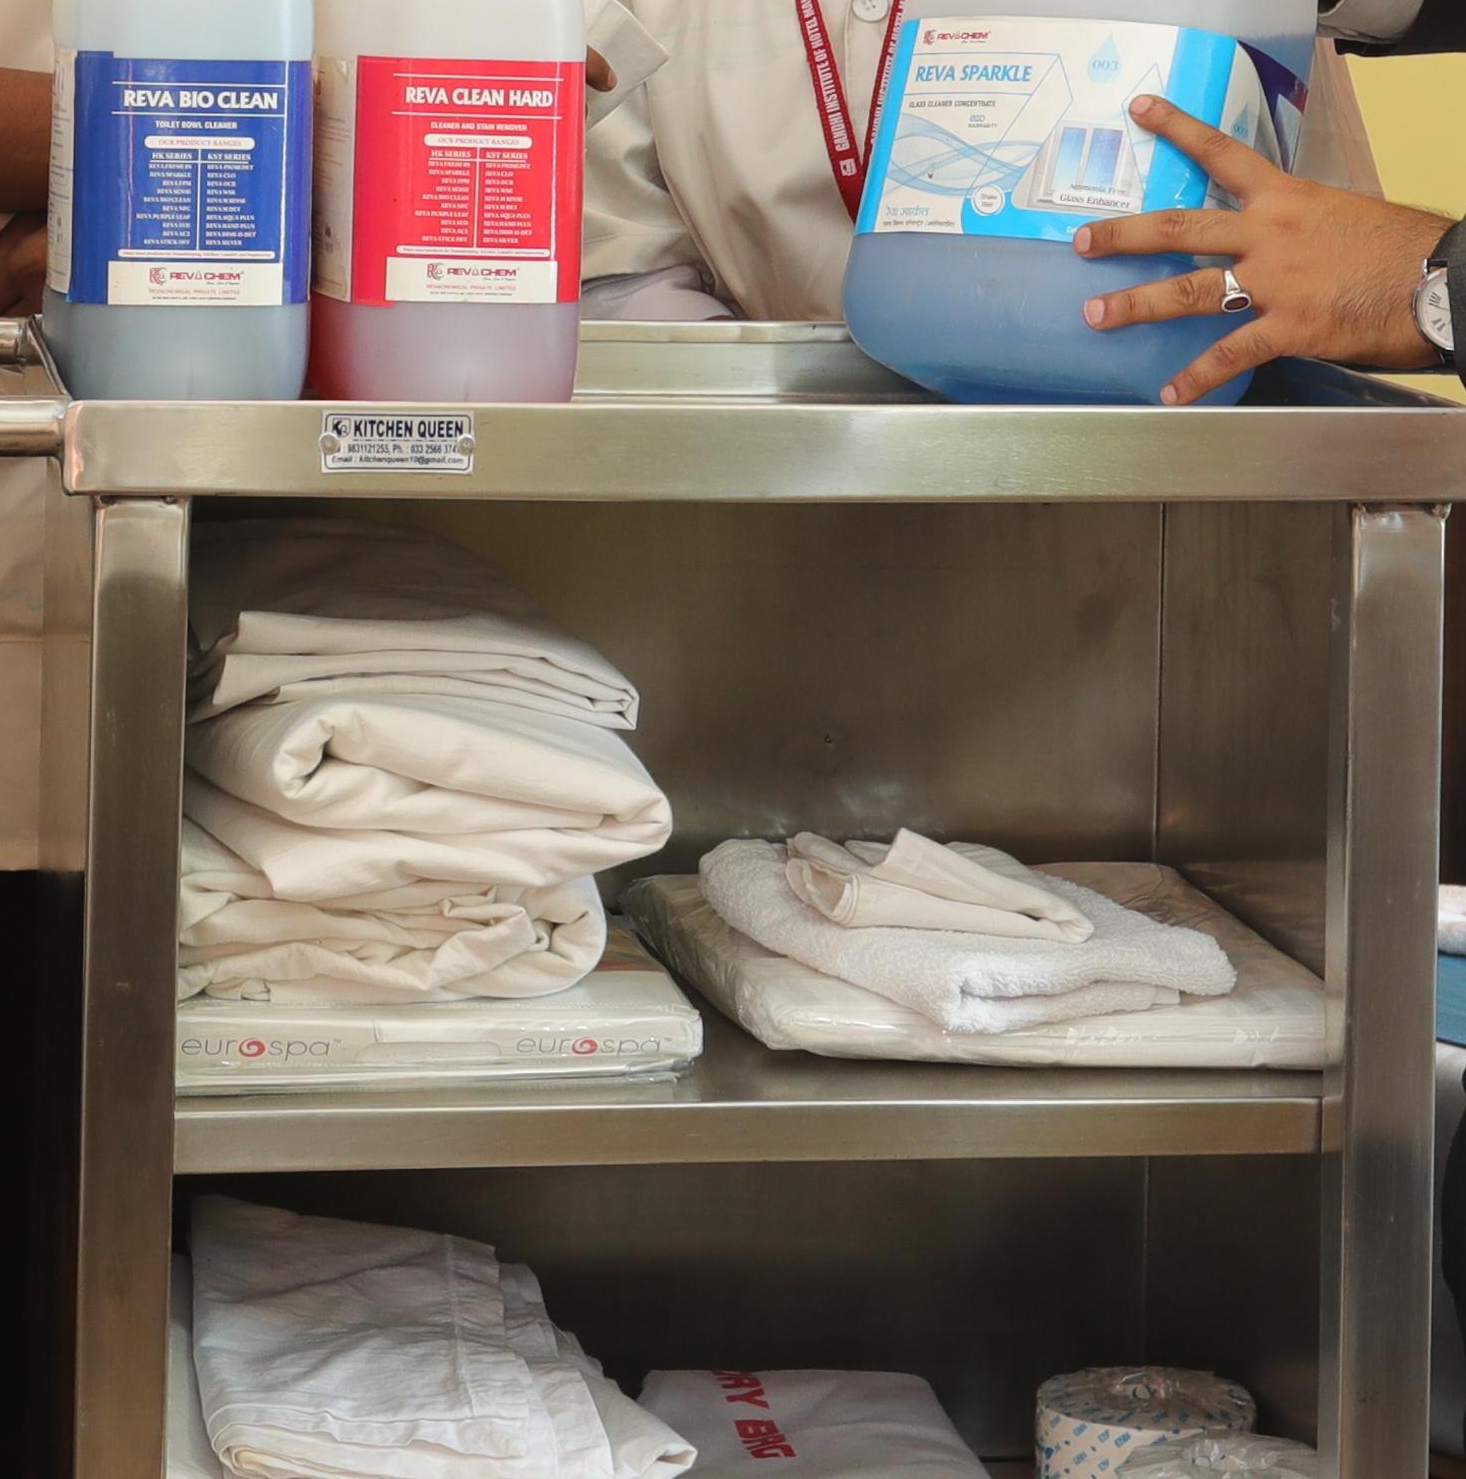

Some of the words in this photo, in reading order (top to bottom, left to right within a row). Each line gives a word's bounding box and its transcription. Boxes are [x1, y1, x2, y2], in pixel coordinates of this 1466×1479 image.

[805, 18, 824, 49] HOTEL
[813, 49, 828, 63] OF
[1092, 60, 1118, 71] 003
[915, 65, 955, 81] REVA
[960, 65, 1033, 81] SPARKLE
[405, 86, 449, 104] REVA
[452, 88, 505, 106] CLEAN
[509, 90, 554, 107] HARD
[817, 62, 840, 113] INSTITUTE
[124, 90, 175, 107] REVA
[179, 91, 215, 108] BIO
[217, 91, 278, 109] CLEAN
[155, 120, 181, 129] TOILET
[204, 121, 238, 129] CLEANER
[431, 122, 460, 130] CLEANER
[828, 111, 851, 152] GANDHI
[1060, 194, 1084, 203] Glass
[1087, 196, 1131, 209] Enhancer
[354, 420, 413, 438] KITCHEN
[417, 421, 464, 439] QUEEN
[181, 1036, 332, 1062] eurospa
[516, 1035, 662, 1058] eurospa
